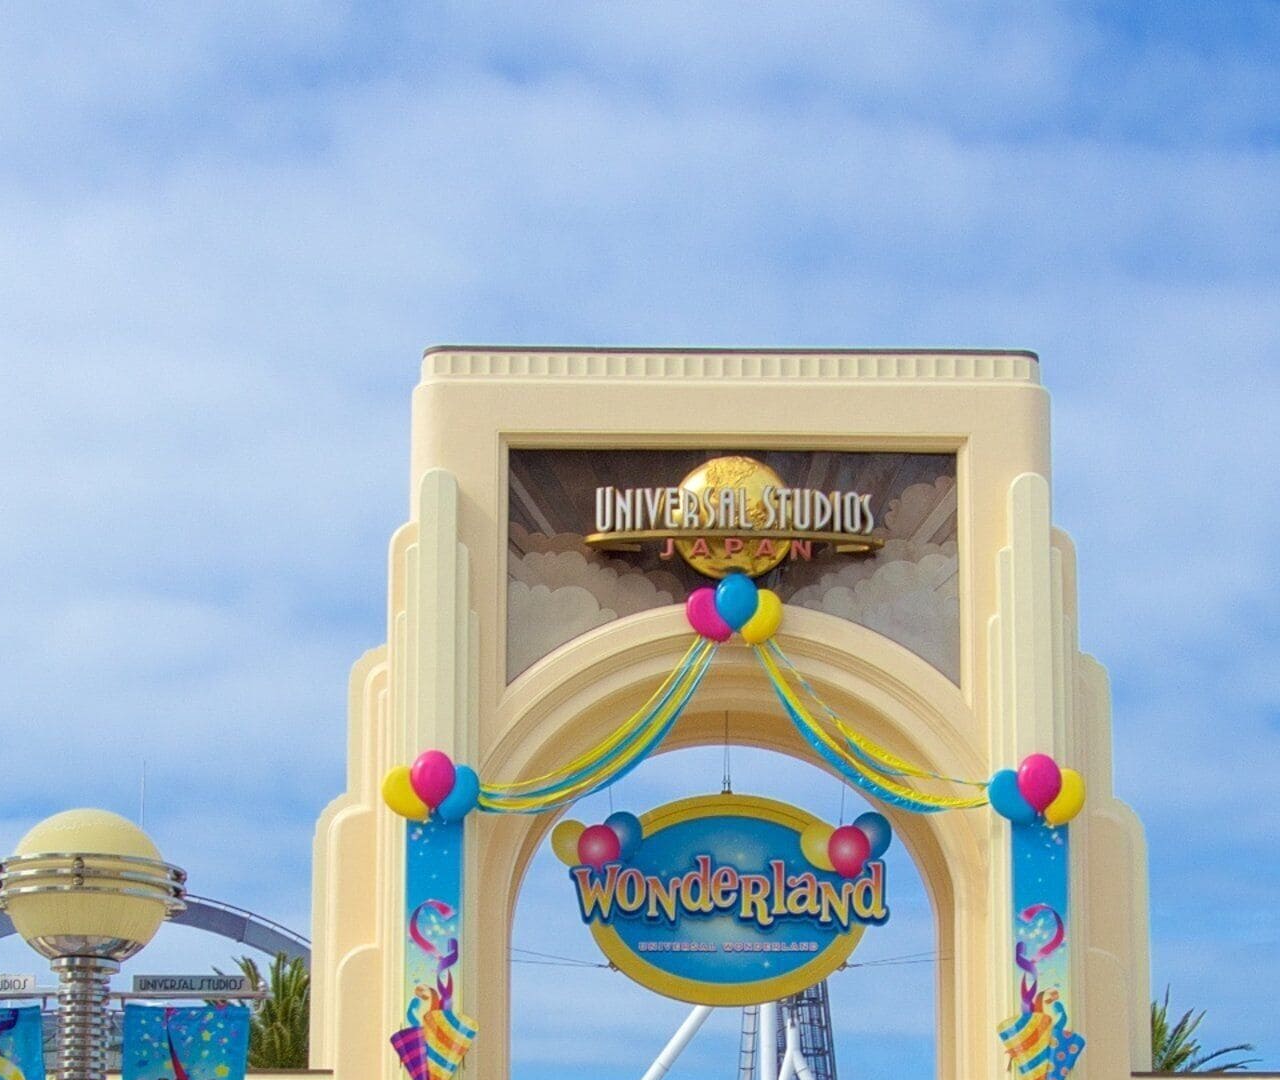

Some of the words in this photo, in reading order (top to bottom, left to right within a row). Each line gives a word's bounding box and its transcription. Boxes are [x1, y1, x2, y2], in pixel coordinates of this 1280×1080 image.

[595, 486, 754, 531] UNIVERSAL
[761, 485, 874, 534] STUDIOS
[659, 537, 814, 561] JAPAN
[638, 941, 717, 952] UNIVERSAL
[723, 941, 819, 952] WONDERLAND
[139, 978, 196, 991] UNIVERSAL
[198, 978, 245, 991] STUDIOS
